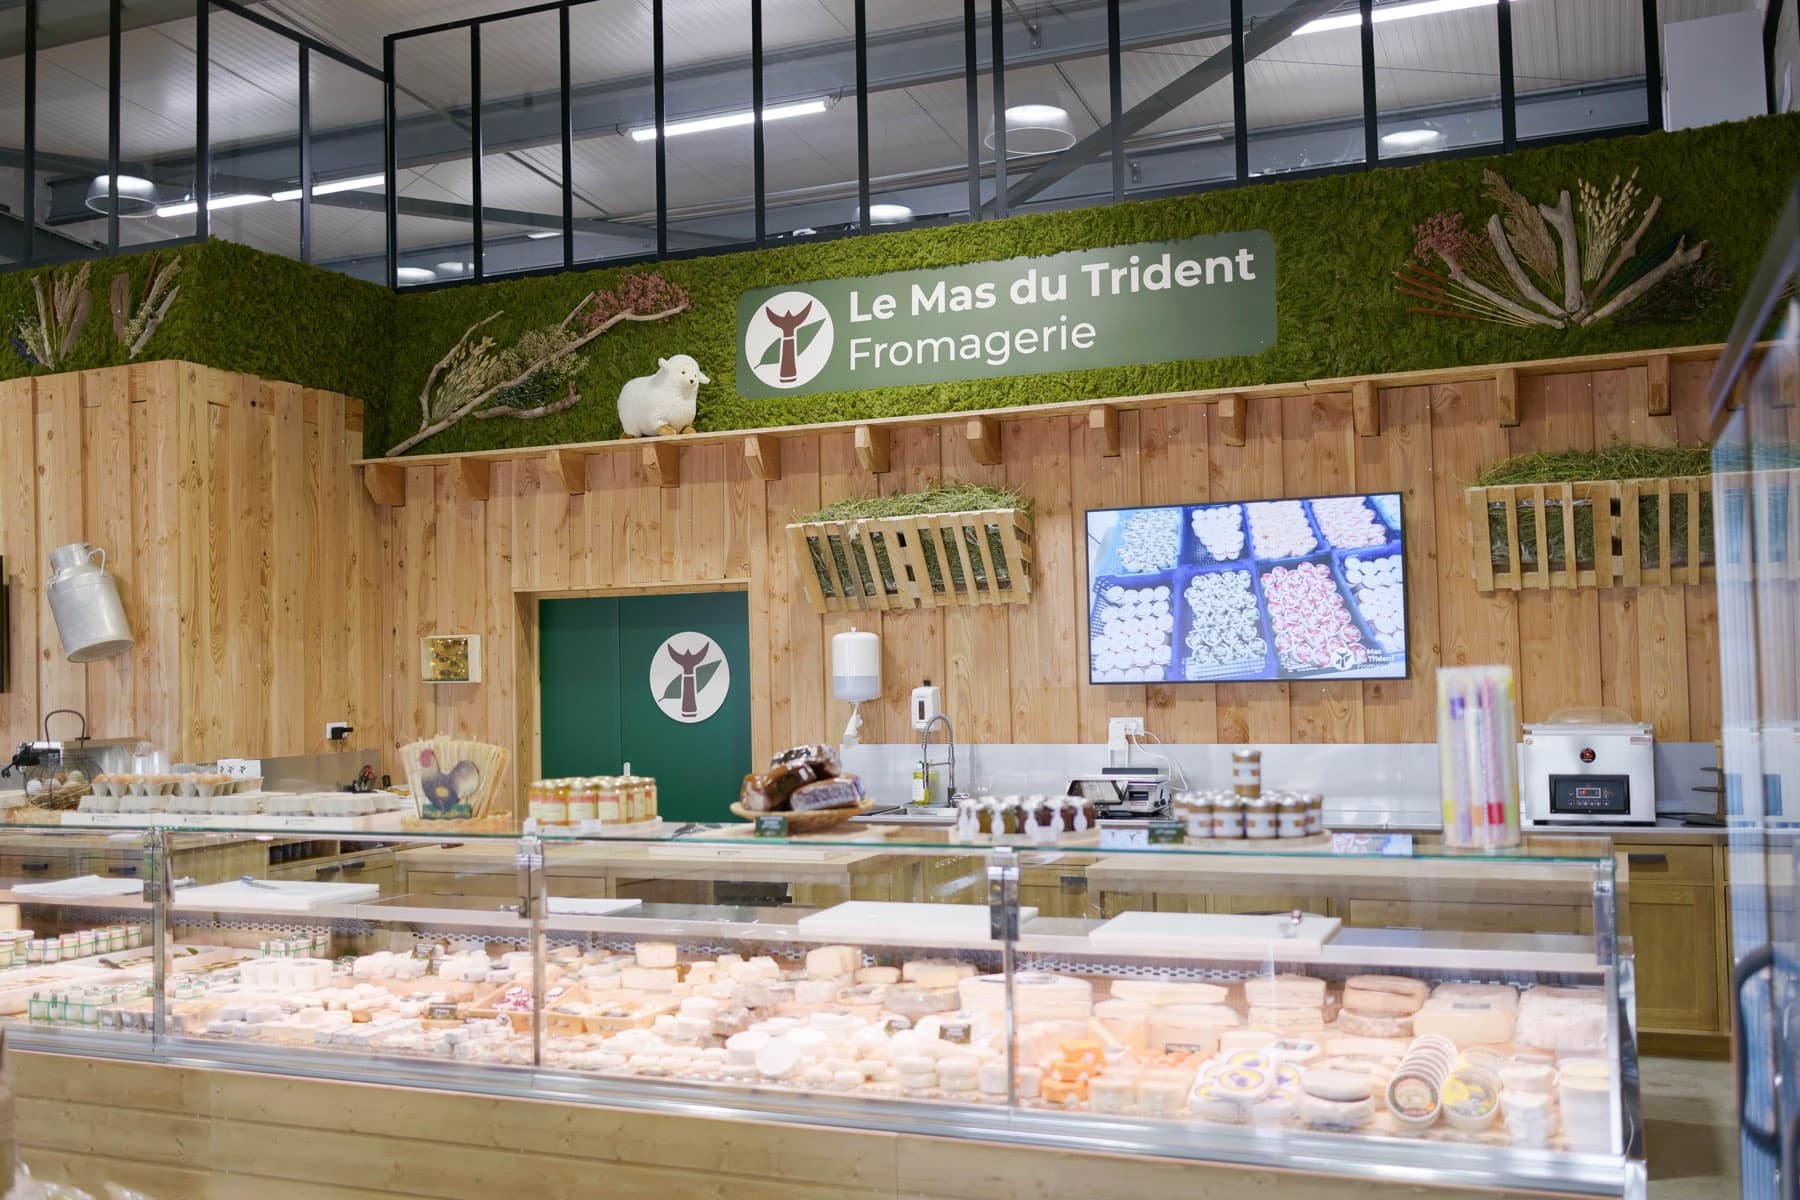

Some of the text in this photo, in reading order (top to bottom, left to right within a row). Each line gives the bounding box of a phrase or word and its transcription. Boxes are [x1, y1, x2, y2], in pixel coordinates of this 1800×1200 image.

[849, 248, 1257, 323] Le Mas du Trident
[849, 317, 1097, 371] Fromagerie
